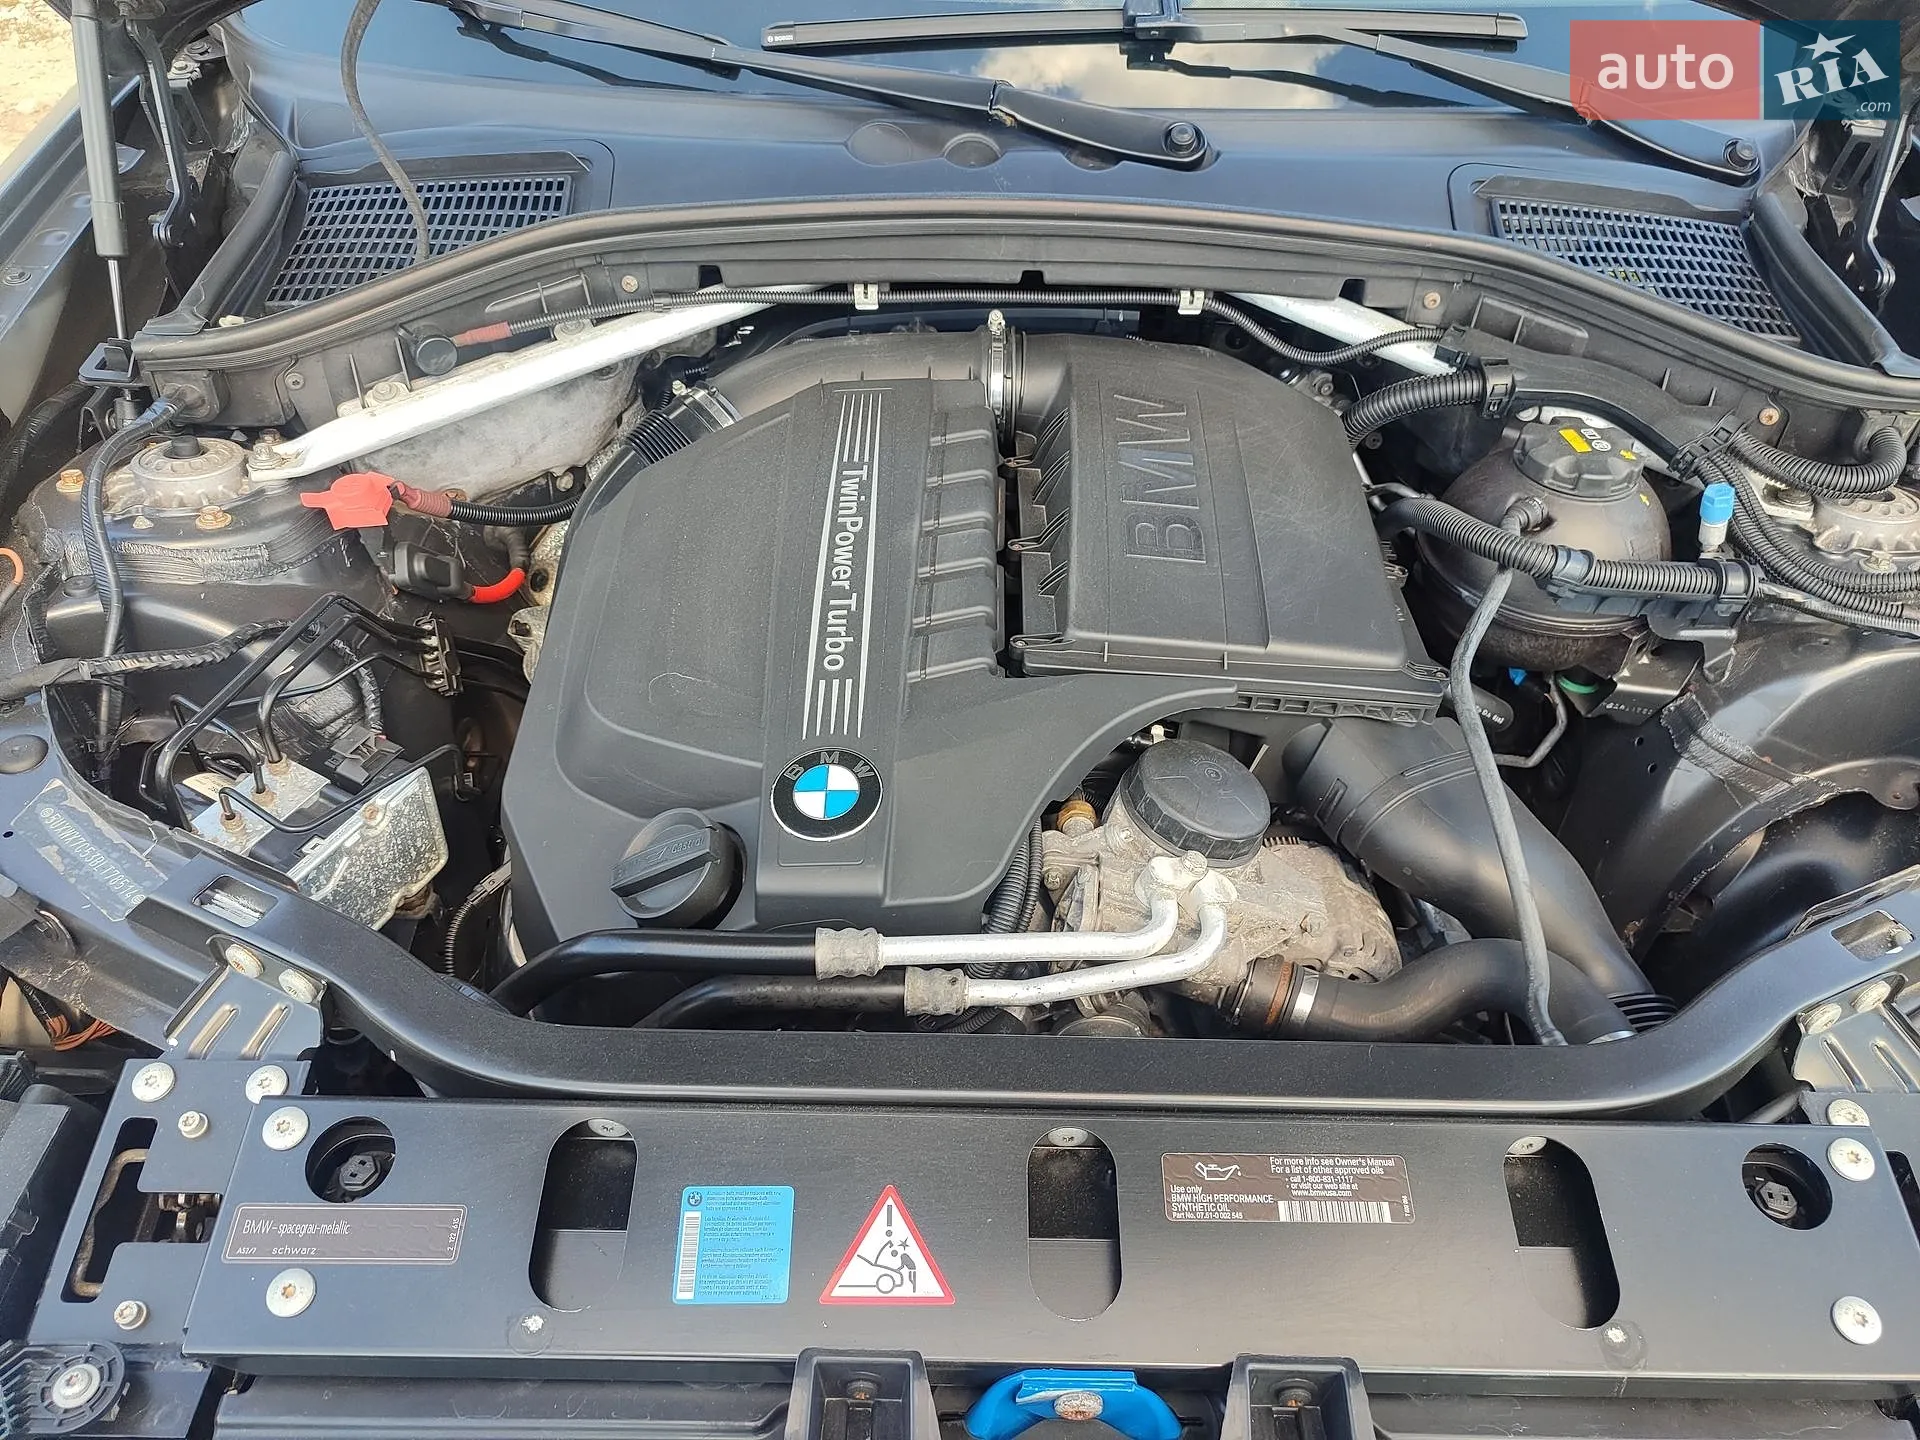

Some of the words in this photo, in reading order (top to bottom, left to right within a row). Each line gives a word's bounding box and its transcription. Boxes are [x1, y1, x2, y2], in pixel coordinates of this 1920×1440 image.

[1114, 394, 1206, 563] BMW
[831, 465, 868, 589] TwinPower
[824, 593, 857, 672] Turbo
[783, 751, 875, 780] BMW
[1270, 1157, 1282, 1165] For
[1335, 1157, 1366, 1166] Owner's
[1367, 1158, 1395, 1167] Manual
[1271, 1165, 1284, 1173] For
[1291, 1165, 1303, 1174] list
[1304, 1165, 1313, 1174] of
[1313, 1165, 1333, 1174] other
[1334, 1166, 1369, 1175] approved
[1371, 1166, 1384, 1175] oils
[1170, 1185, 1185, 1193] Use
[1186, 1185, 1202, 1195] only
[1291, 1189, 1352, 1197] www.bmwusa.com
[1171, 1194, 1191, 1202] BMW
[1193, 1194, 1213, 1202] HIGH
[1214, 1194, 1274, 1203] PERFORMANCE
[1172, 1203, 1216, 1211] SYNTHETIC
[1217, 1203, 1230, 1211] OIL
[272, 1245, 317, 1256] schwarz
